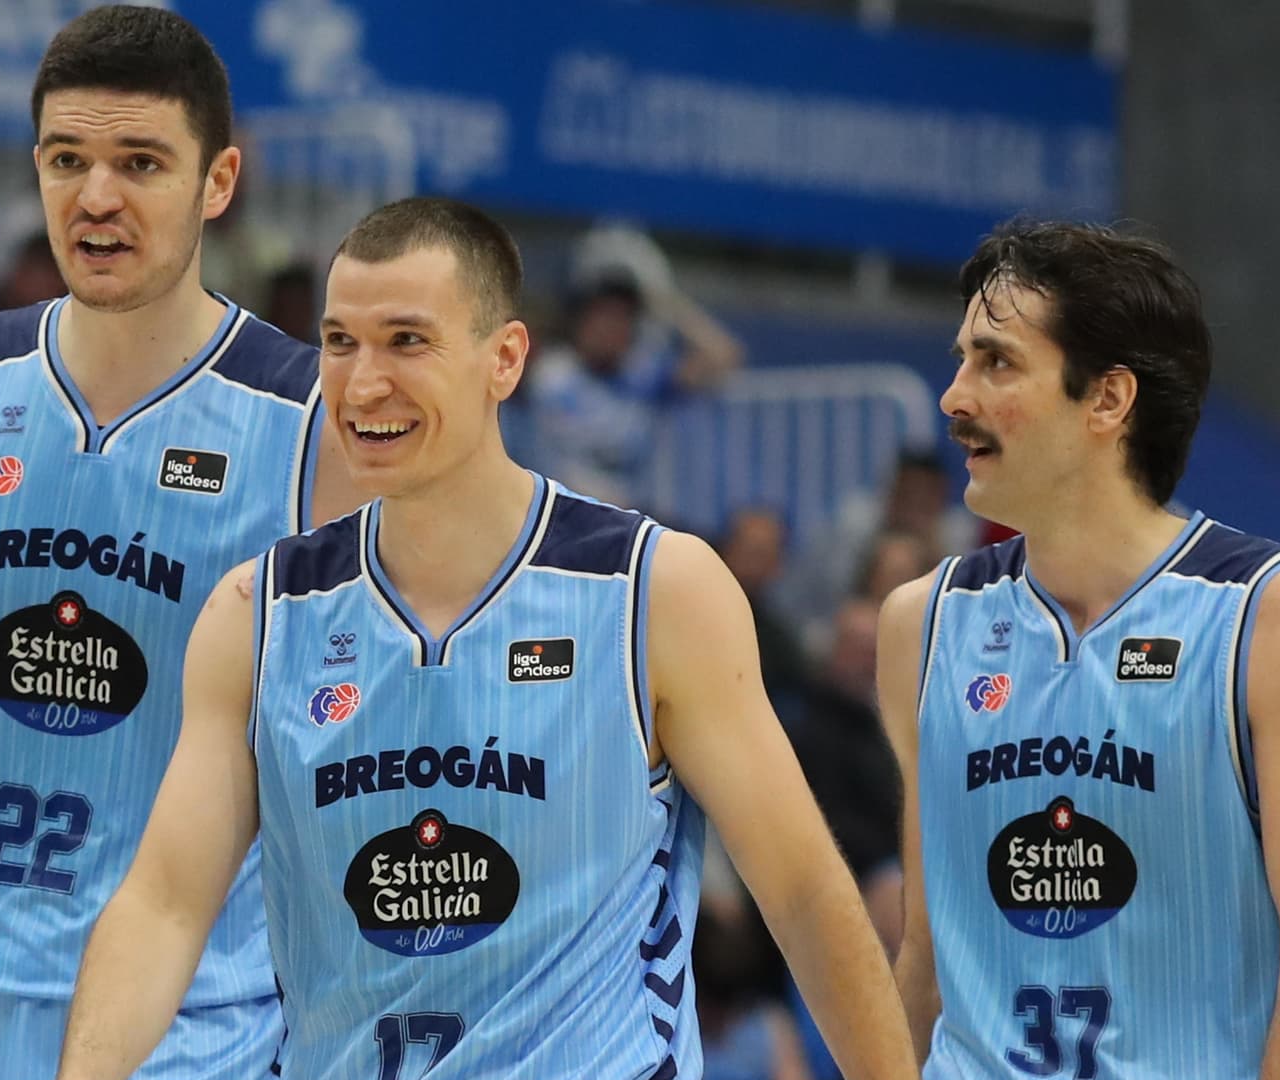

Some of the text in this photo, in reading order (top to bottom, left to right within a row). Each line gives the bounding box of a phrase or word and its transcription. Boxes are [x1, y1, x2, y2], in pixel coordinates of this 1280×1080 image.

[165, 472, 220, 491] endesa
[168, 460, 193, 476] liga
[7, 628, 118, 672] Estrella
[513, 652, 539, 668] liga
[1122, 649, 1147, 664] liga
[11, 663, 111, 704] Galicia
[513, 662, 570, 678] endesa
[1121, 660, 1172, 676] endesa
[315, 736, 546, 808] BREOGÁN
[966, 729, 1155, 793] BREOGÁN
[1007, 836, 1105, 869] Estrella
[368, 852, 489, 887] Estrella
[373, 886, 481, 921] Galicia
